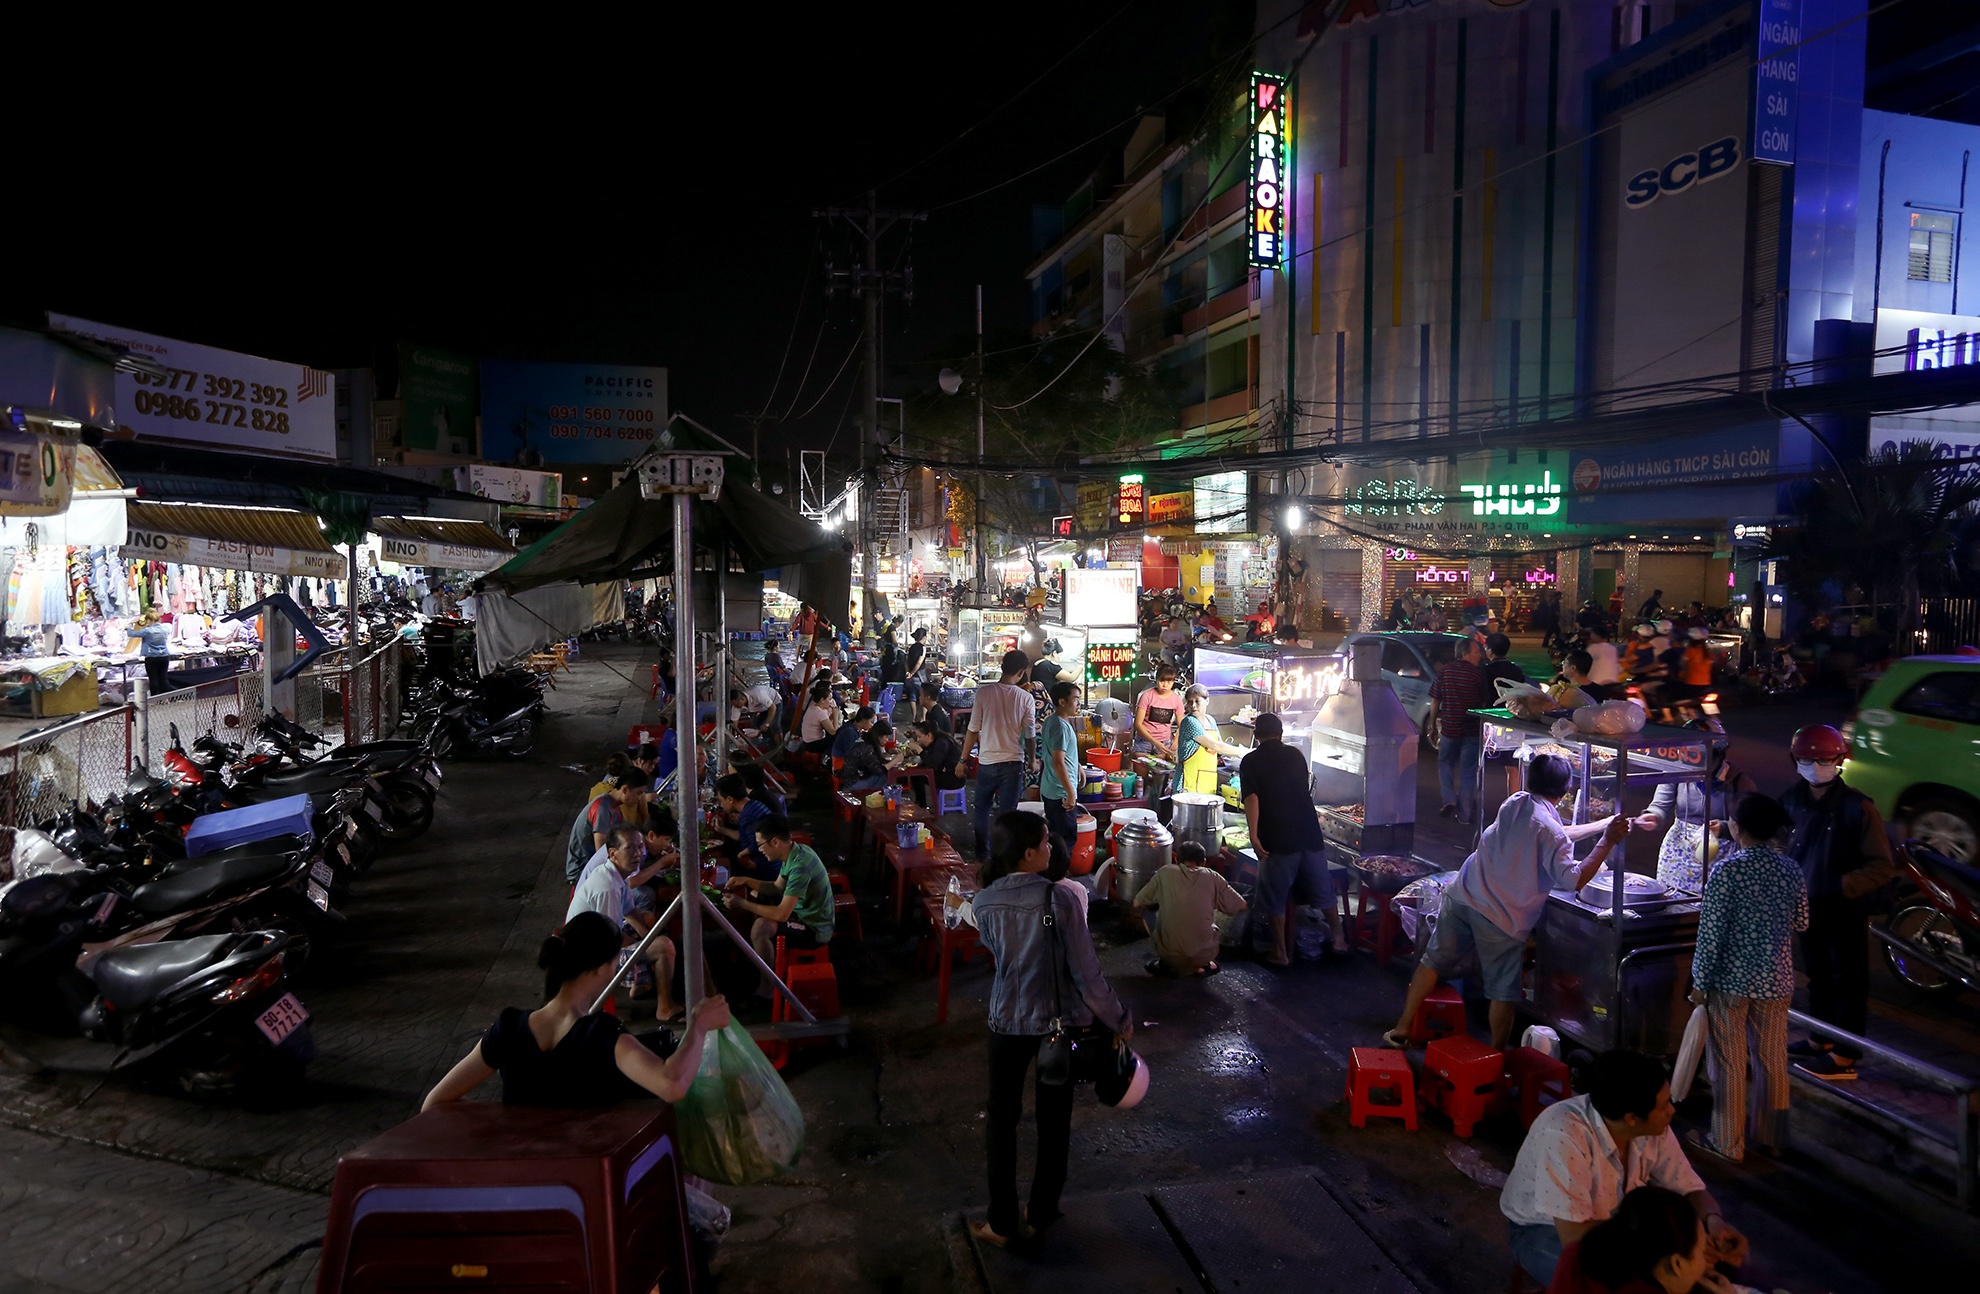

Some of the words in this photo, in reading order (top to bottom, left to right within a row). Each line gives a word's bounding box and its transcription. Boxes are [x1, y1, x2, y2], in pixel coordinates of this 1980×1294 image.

[1763, 20, 1798, 45] NGÂN
[1767, 91, 1787, 116] SÀI
[1761, 126, 1788, 152] GÒN
[1257, 83, 1278, 258] KARAOKE
[1626, 137, 1739, 206] SCB
[204, 373, 246, 401] 392
[250, 382, 289, 409] 392
[585, 376, 653, 388] PACIFIC
[585, 389, 653, 398] OUTDOOR
[135, 389, 201, 422] 0986
[206, 400, 248, 429] 272
[251, 407, 290, 435] 828
[551, 406, 578, 420] 091
[584, 407, 611, 421] 560
[617, 408, 653, 422] 7000
[551, 425, 579, 439] 090
[585, 426, 612, 439] 704
[617, 427, 654, 441] 6206
[1603, 460, 1634, 480] NGÂN
[1637, 457, 1671, 477] HÀNG
[1675, 455, 1709, 473] TMCP
[1713, 449, 1735, 470] SÀI
[1739, 445, 1770, 467] GÒN
[1120, 499, 1142, 512] HOA
[1377, 522, 1400, 531] 91A7
[1505, 522, 1529, 532] Q.TB
[207, 537, 274, 557] FASHION
[386, 540, 417, 556] NNO
[442, 544, 488, 559] FASHION
[304, 556, 323, 567] NNO
[1415, 565, 1457, 582] HỒNG
[1069, 573, 1101, 594] BÁ
[1012, 613, 1023, 622] kho
[1090, 645, 1111, 663] BÁNH
[1113, 648, 1133, 663] CANH
[1102, 665, 1121, 679] CUA
[263, 999, 292, 1027] 60-T8
[272, 1010, 302, 1039] 7721
